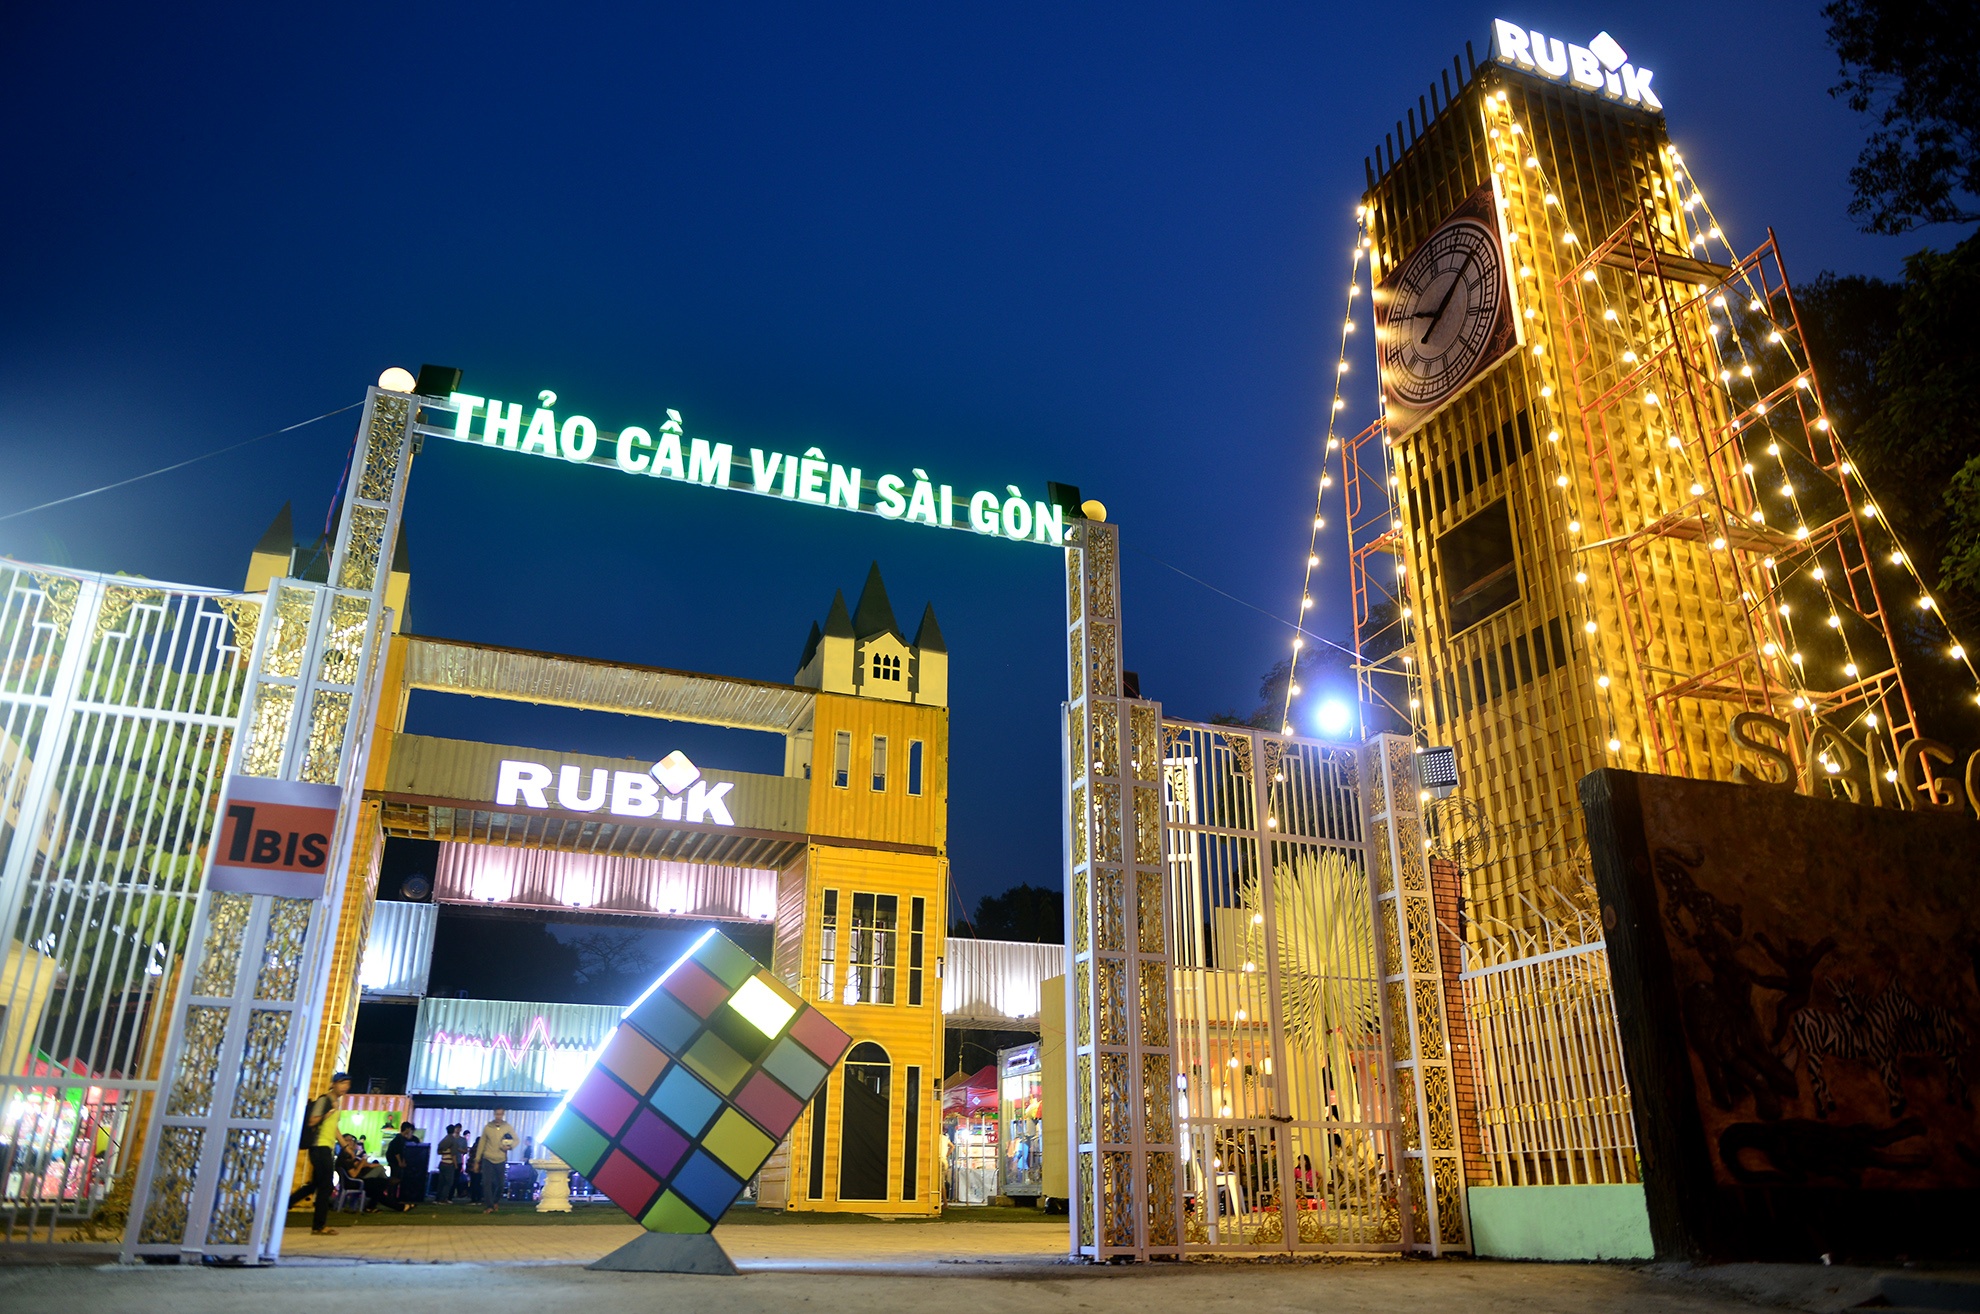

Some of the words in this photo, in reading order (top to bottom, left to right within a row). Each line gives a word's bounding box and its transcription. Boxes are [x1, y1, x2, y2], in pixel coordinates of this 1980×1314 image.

[449, 390, 598, 463] THẢO
[616, 408, 733, 490] CẦM
[750, 446, 861, 511] VIÊN
[875, 467, 953, 529] SÀI
[969, 484, 1063, 547] GÒN
[1729, 711, 1980, 819] SAIG
